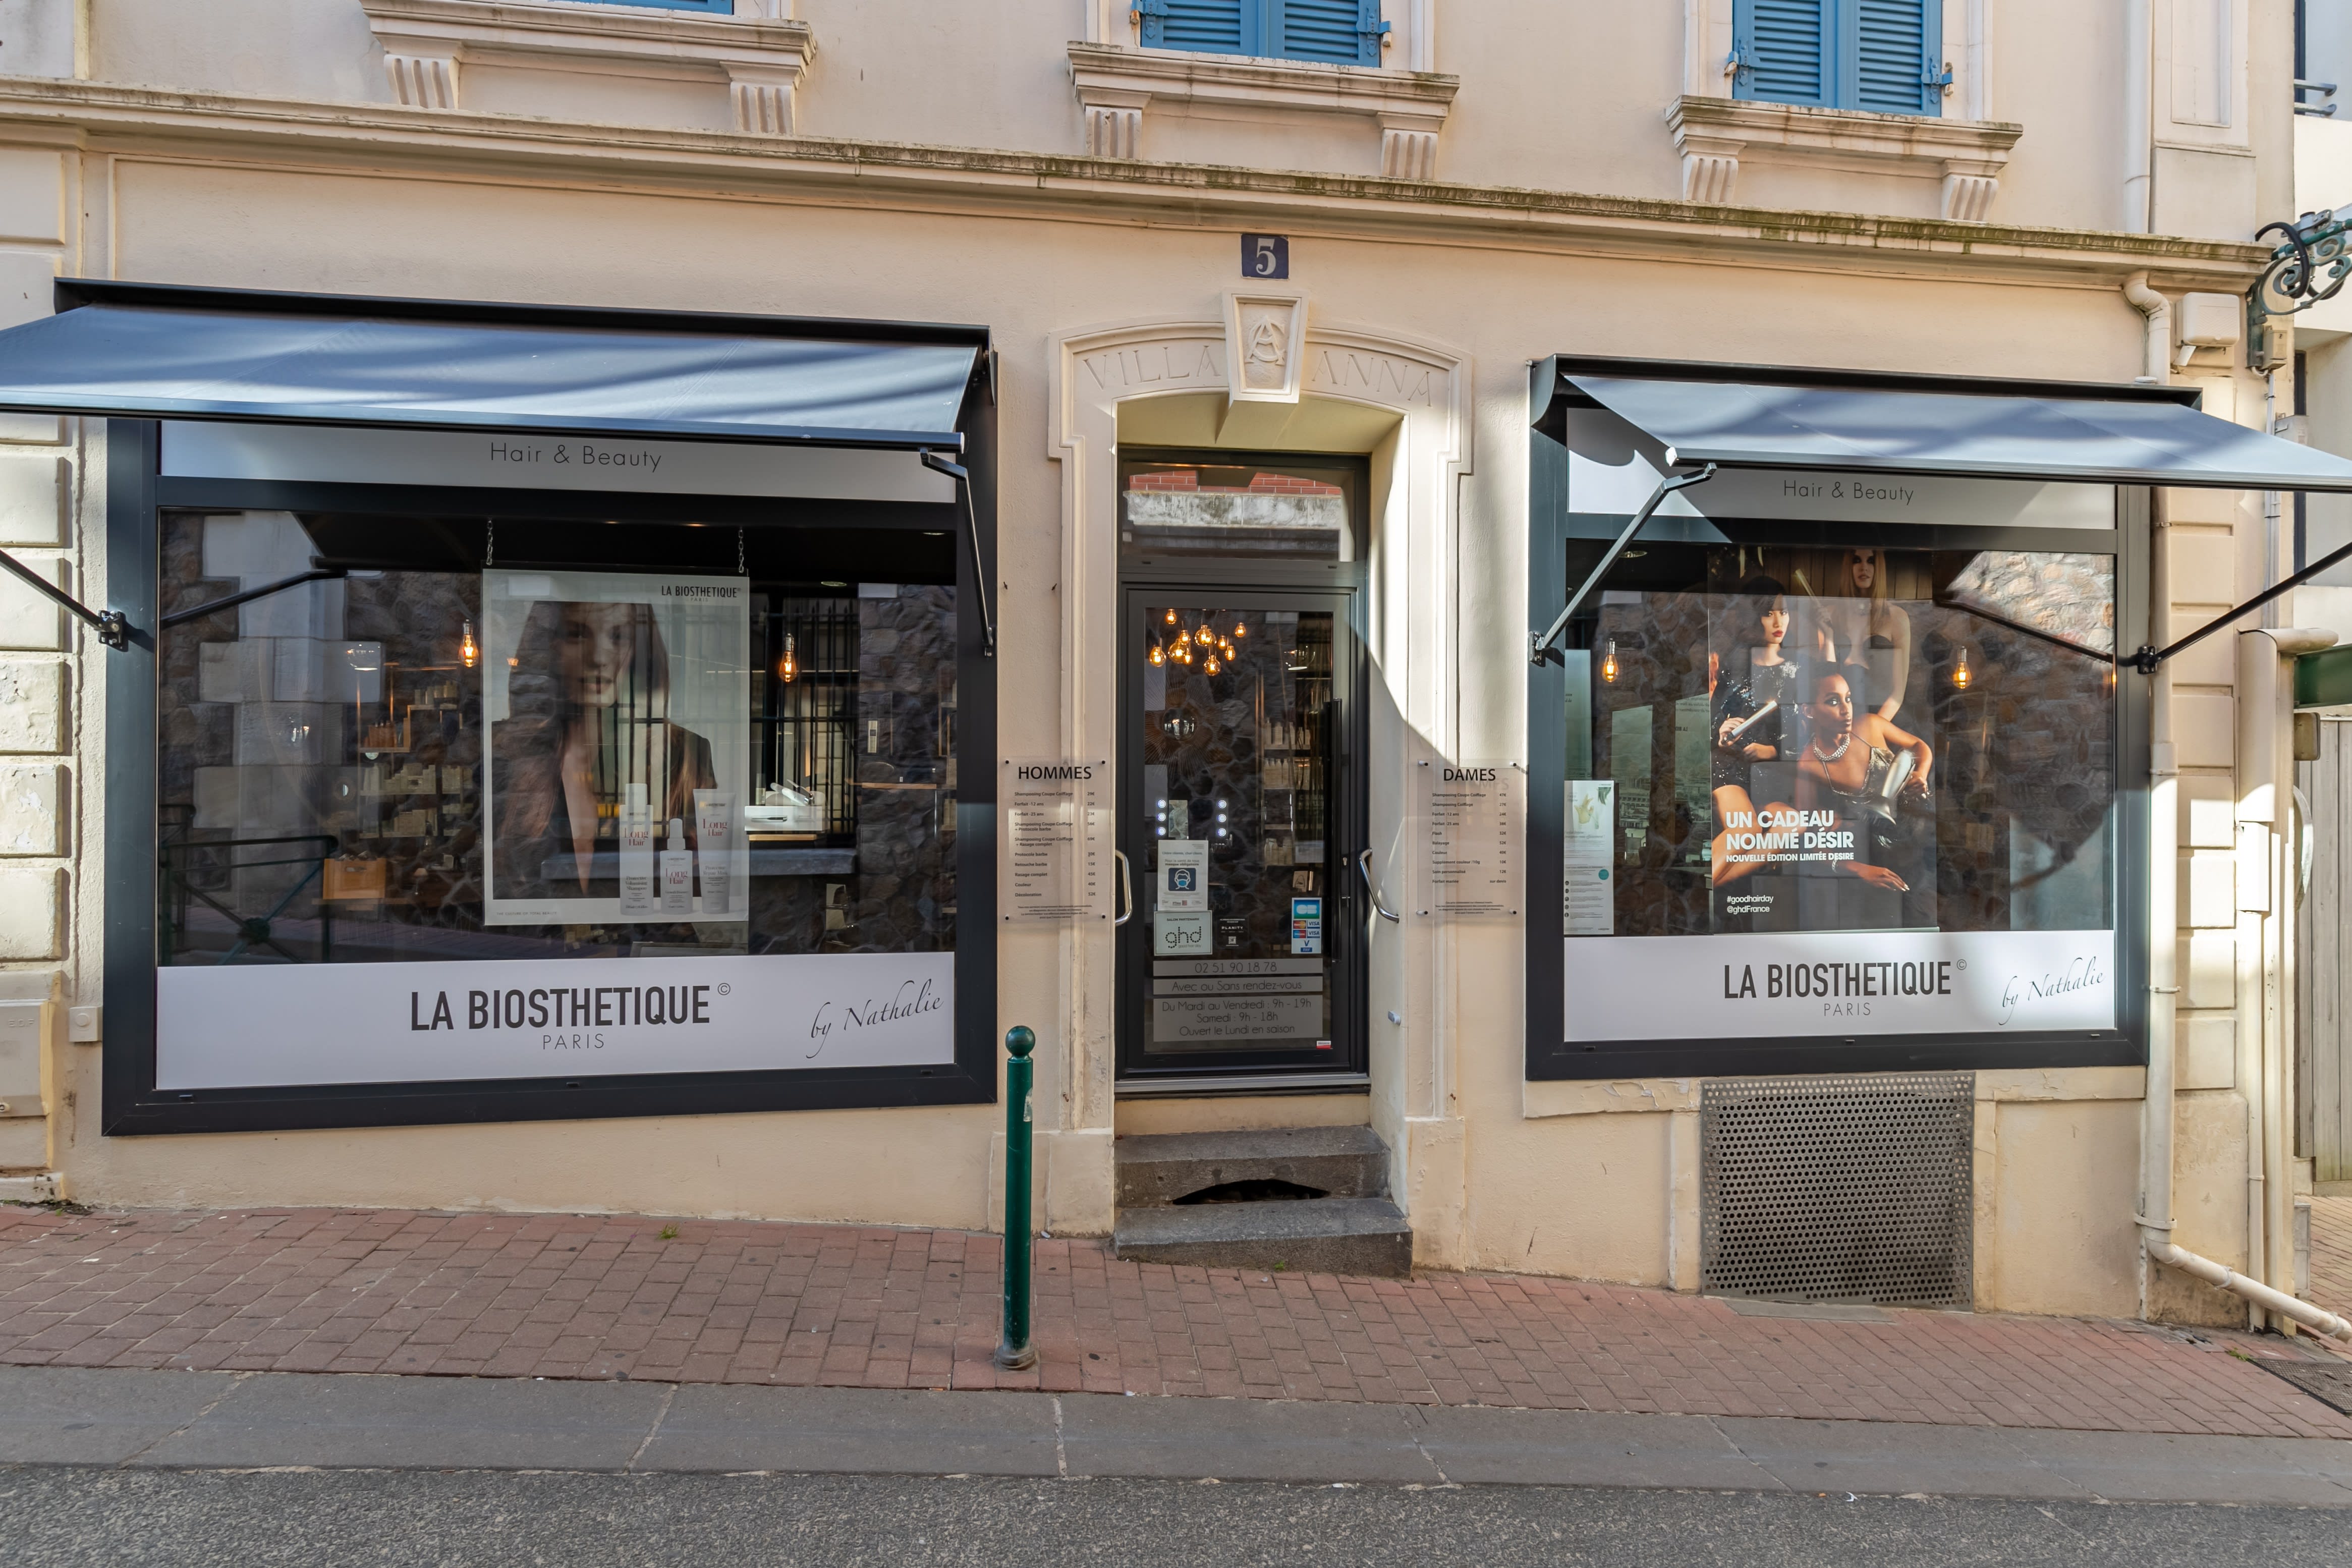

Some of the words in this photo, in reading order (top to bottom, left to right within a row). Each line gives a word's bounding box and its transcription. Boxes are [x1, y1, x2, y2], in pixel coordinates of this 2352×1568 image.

[1256, 238, 1276, 275] 5
[1082, 345, 1222, 391] VILLA
[1312, 351, 1434, 407] ANNA
[491, 442, 541, 462] Hair
[554, 444, 570, 464] &
[583, 445, 661, 473] Beauty
[1784, 480, 1822, 497] Hair
[1832, 481, 1844, 498] &
[1854, 482, 1914, 506] Beauty
[661, 585, 672, 596] LA
[1018, 766, 1092, 779] HOMMES
[1443, 768, 1496, 781] DAMES
[703, 818, 727, 830] Long
[1726, 812, 1752, 828] UN
[1758, 810, 1834, 828] CADEAU
[625, 827, 648, 840] Long
[1726, 828, 1799, 850] NOMMÉ
[1804, 827, 1854, 849] DÉSIR
[1726, 854, 1765, 862] NOUVELLE
[1767, 853, 1798, 861] ÉDITION
[1800, 852, 1826, 861] LIMITÉE
[666, 868, 688, 879] Long
[1727, 895, 1774, 904] #goodhairday
[1296, 905, 1317, 914] CB
[1727, 905, 1770, 914] @ghdFrance
[1165, 926, 1201, 948] ghd
[1195, 963, 1208, 973] 02
[1212, 963, 1225, 973] 51
[1230, 963, 1243, 973] 90
[1247, 962, 1260, 972] 18
[1264, 962, 1277, 972] 78
[1172, 982, 1197, 991] Avec
[1217, 981, 1240, 990] Sans
[1243, 980, 1302, 990] rendez-vous
[1724, 965, 1757, 999] LA
[1998, 976, 2018, 1025] by
[2028, 956, 2106, 1001] Nathalie
[411, 991, 454, 1031] LA
[1162, 1002, 1175, 1011] Du
[1179, 1001, 1205, 1011] Mardi
[1223, 1000, 1265, 1009] Vendredi
[1272, 999, 1283, 1007] 9h
[1294, 998, 1311, 1007] 19h
[1824, 1002, 1871, 1017] PARIS
[806, 1002, 831, 1058] by
[844, 979, 944, 1031] Nathalie
[1197, 1014, 1231, 1023] Samedi
[1239, 1012, 1250, 1021] 9h
[1261, 1012, 1278, 1021] 18h
[1179, 1026, 1211, 1036] Ouvert
[1214, 1027, 1222, 1035] le
[1225, 1026, 1249, 1034] Lundi
[543, 1033, 604, 1050] PARIS
